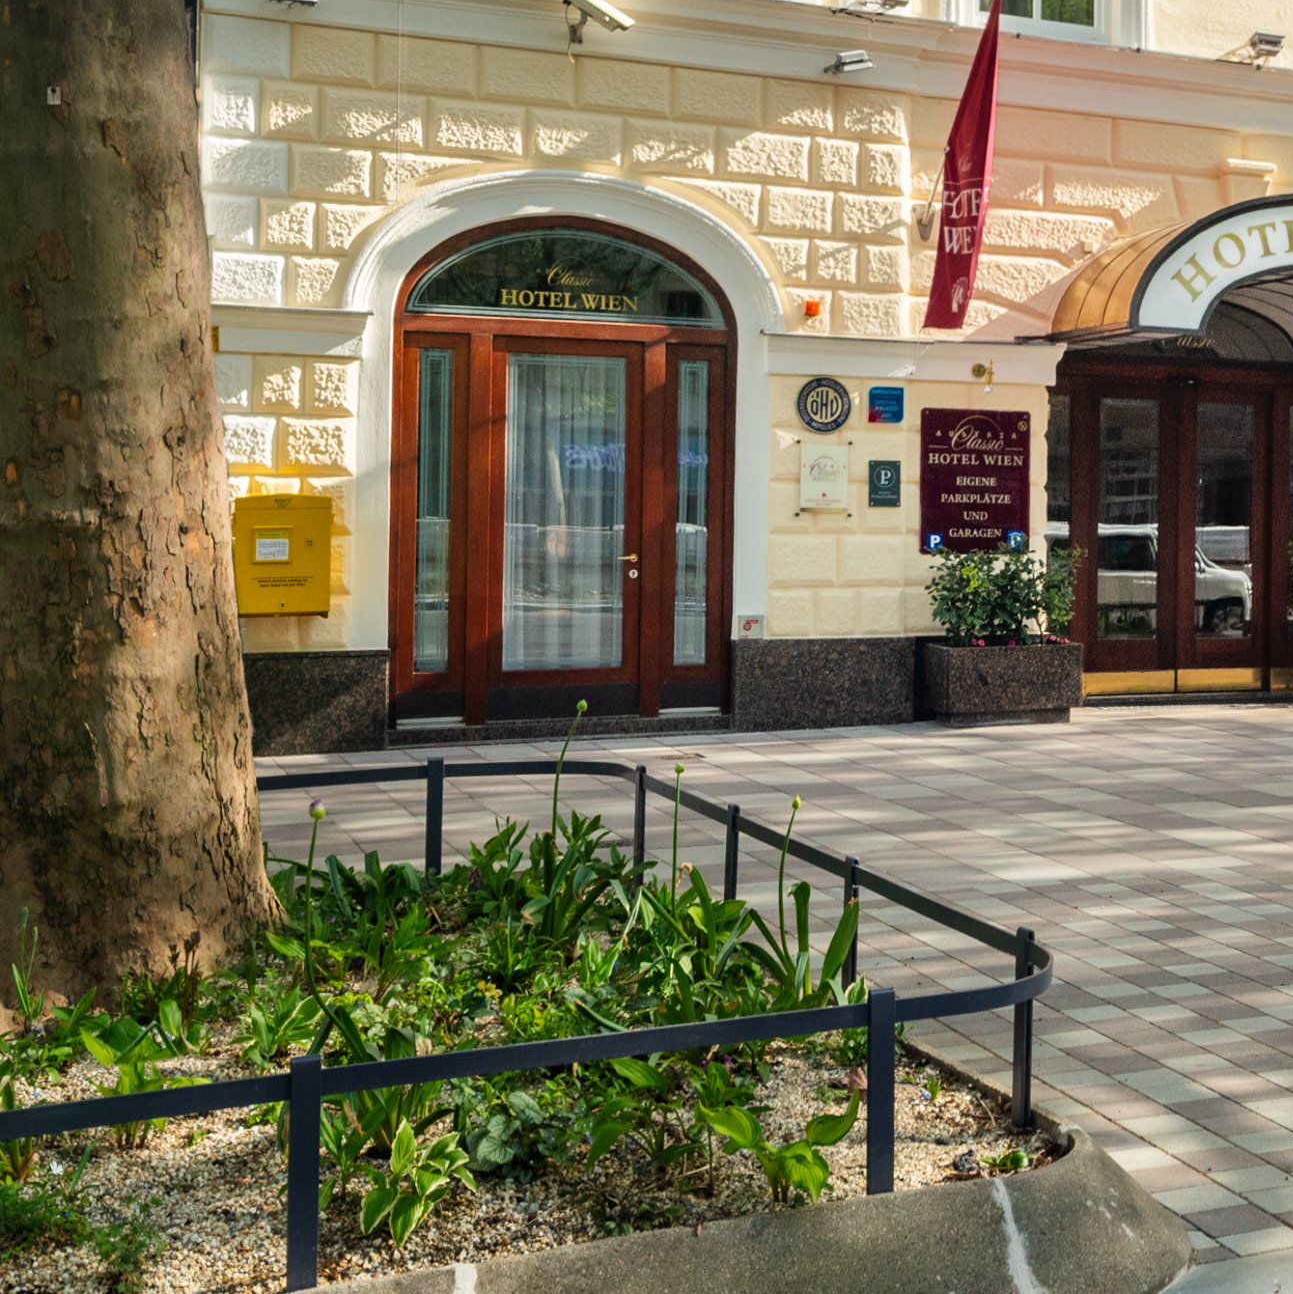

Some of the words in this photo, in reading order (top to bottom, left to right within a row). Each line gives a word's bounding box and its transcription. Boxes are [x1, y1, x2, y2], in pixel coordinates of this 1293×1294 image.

[501, 289, 577, 309] HOTEL
[580, 293, 638, 312] WIEN
[951, 424, 1005, 451] Classic
[928, 452, 980, 465] HOTEL
[983, 455, 1024, 466] WIEN
[956, 476, 997, 487] EIGENE
[940, 492, 1011, 504] PARKPLÄTZE
[963, 510, 988, 521] UND
[949, 528, 1002, 538] GARAGEN
